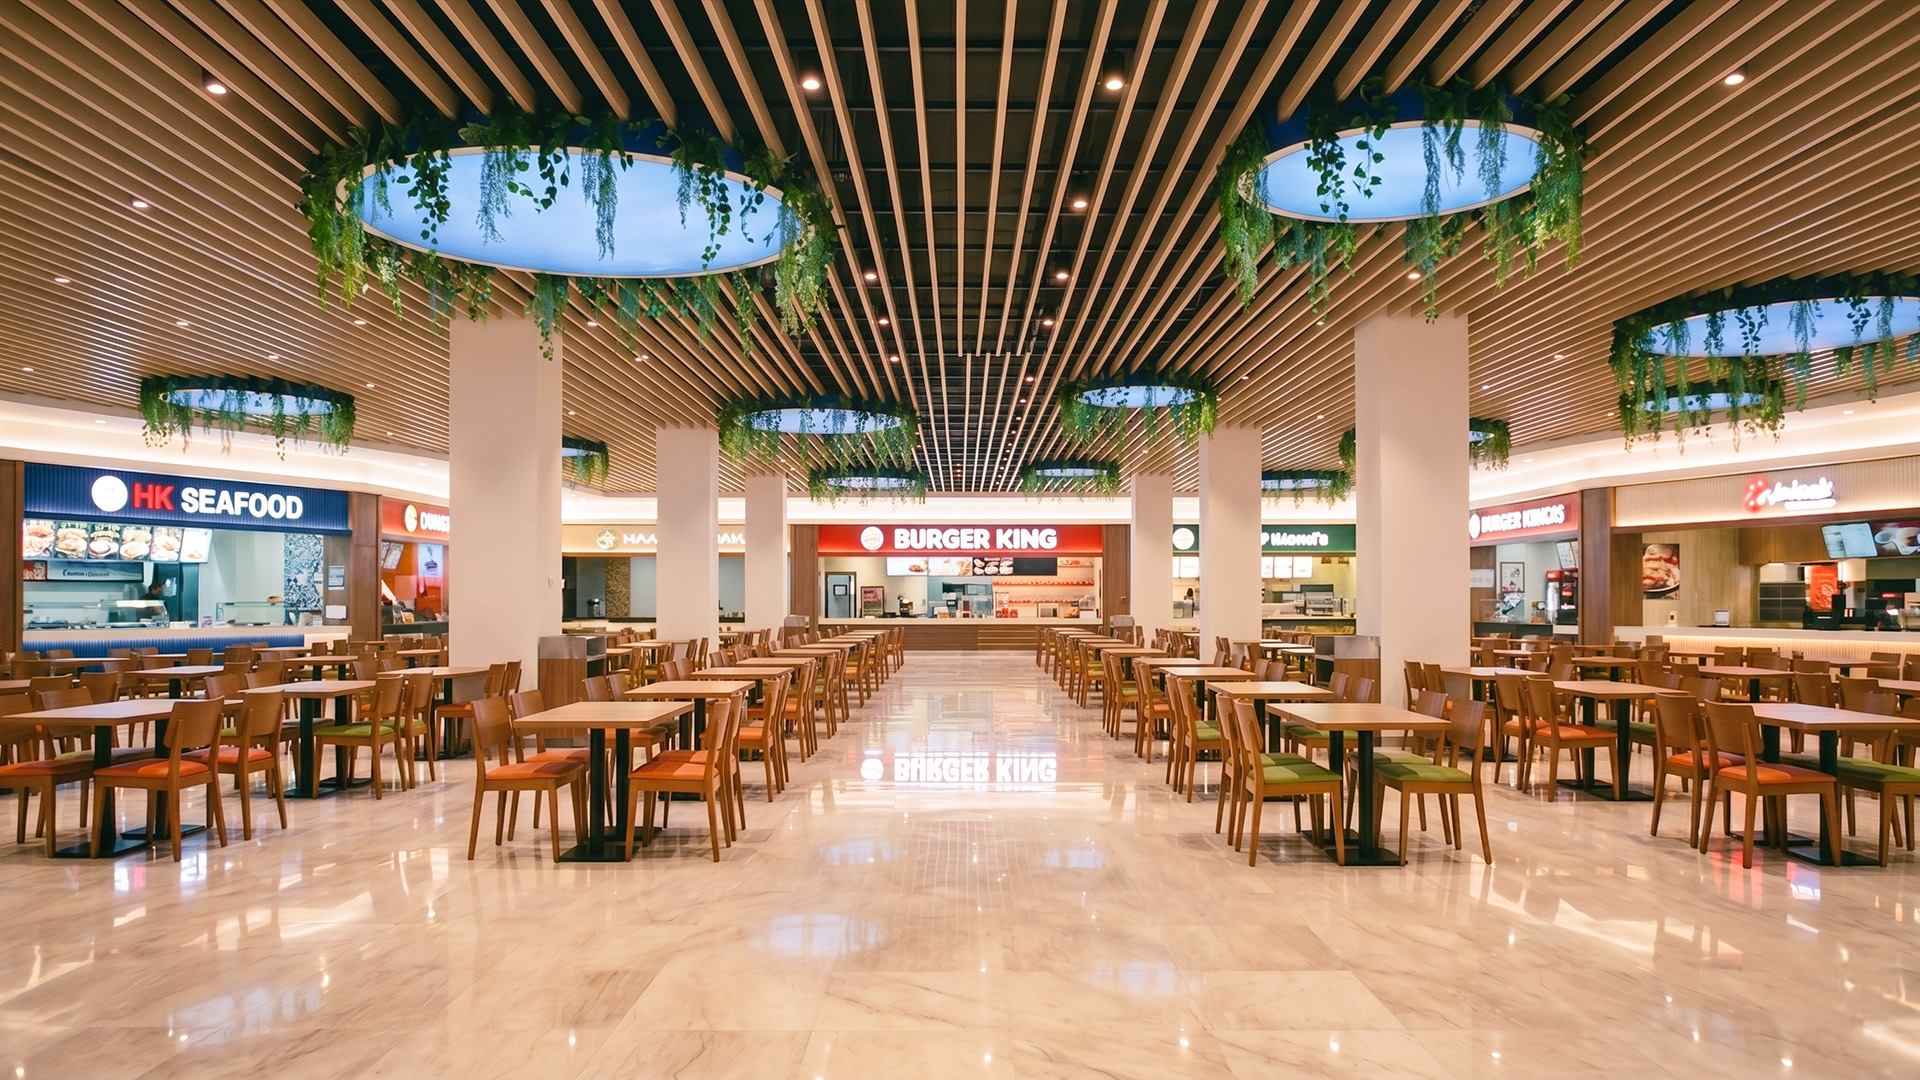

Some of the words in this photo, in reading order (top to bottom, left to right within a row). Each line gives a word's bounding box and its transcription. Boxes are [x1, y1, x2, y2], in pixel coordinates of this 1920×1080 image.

[133, 482, 174, 511] HK
[181, 487, 303, 519] SEAFOOD
[1481, 511, 1522, 533] BURGER
[894, 528, 990, 550] BURGER
[996, 528, 1057, 550] KING
